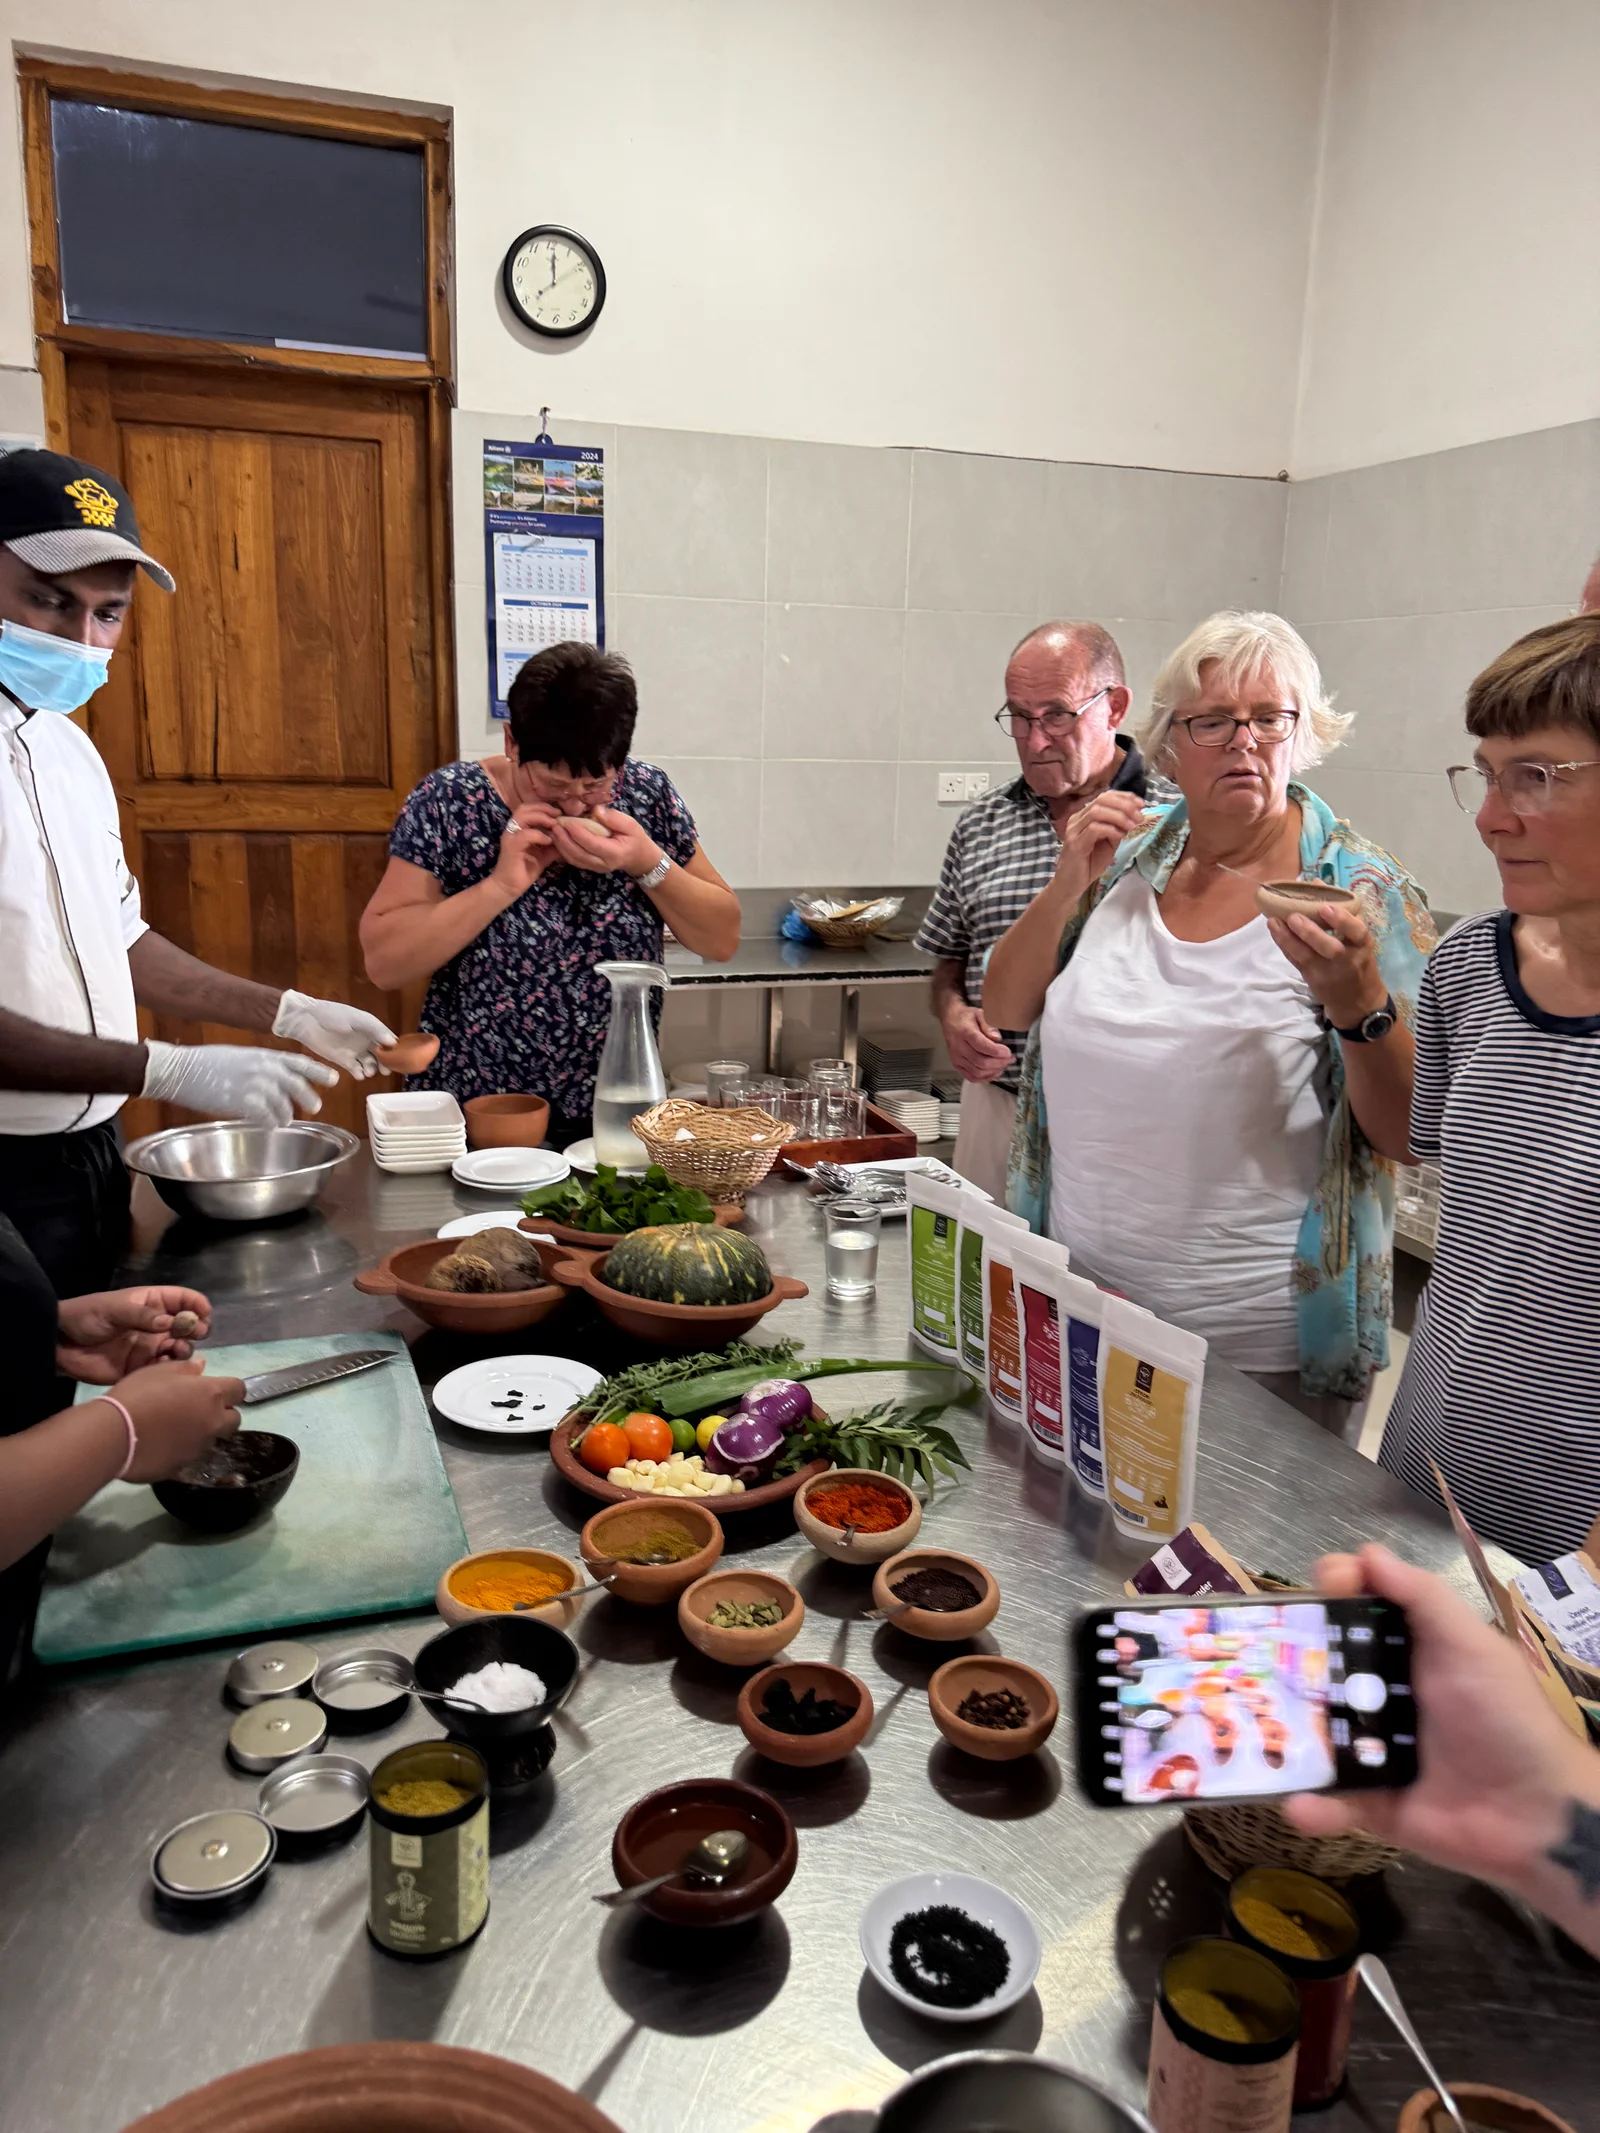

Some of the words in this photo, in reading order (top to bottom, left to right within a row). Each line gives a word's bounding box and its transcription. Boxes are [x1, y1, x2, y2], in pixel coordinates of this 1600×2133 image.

[529, 243, 539, 253] 11
[546, 240, 558, 250] 12
[566, 247, 572, 257] 1
[516, 257, 529, 268] 10
[515, 276, 523, 286] 9
[584, 280, 592, 290] 3
[536, 307, 544, 318] 7
[569, 310, 578, 321] 5
[552, 314, 560, 324] 6
[580, 452, 599, 460] 2024
